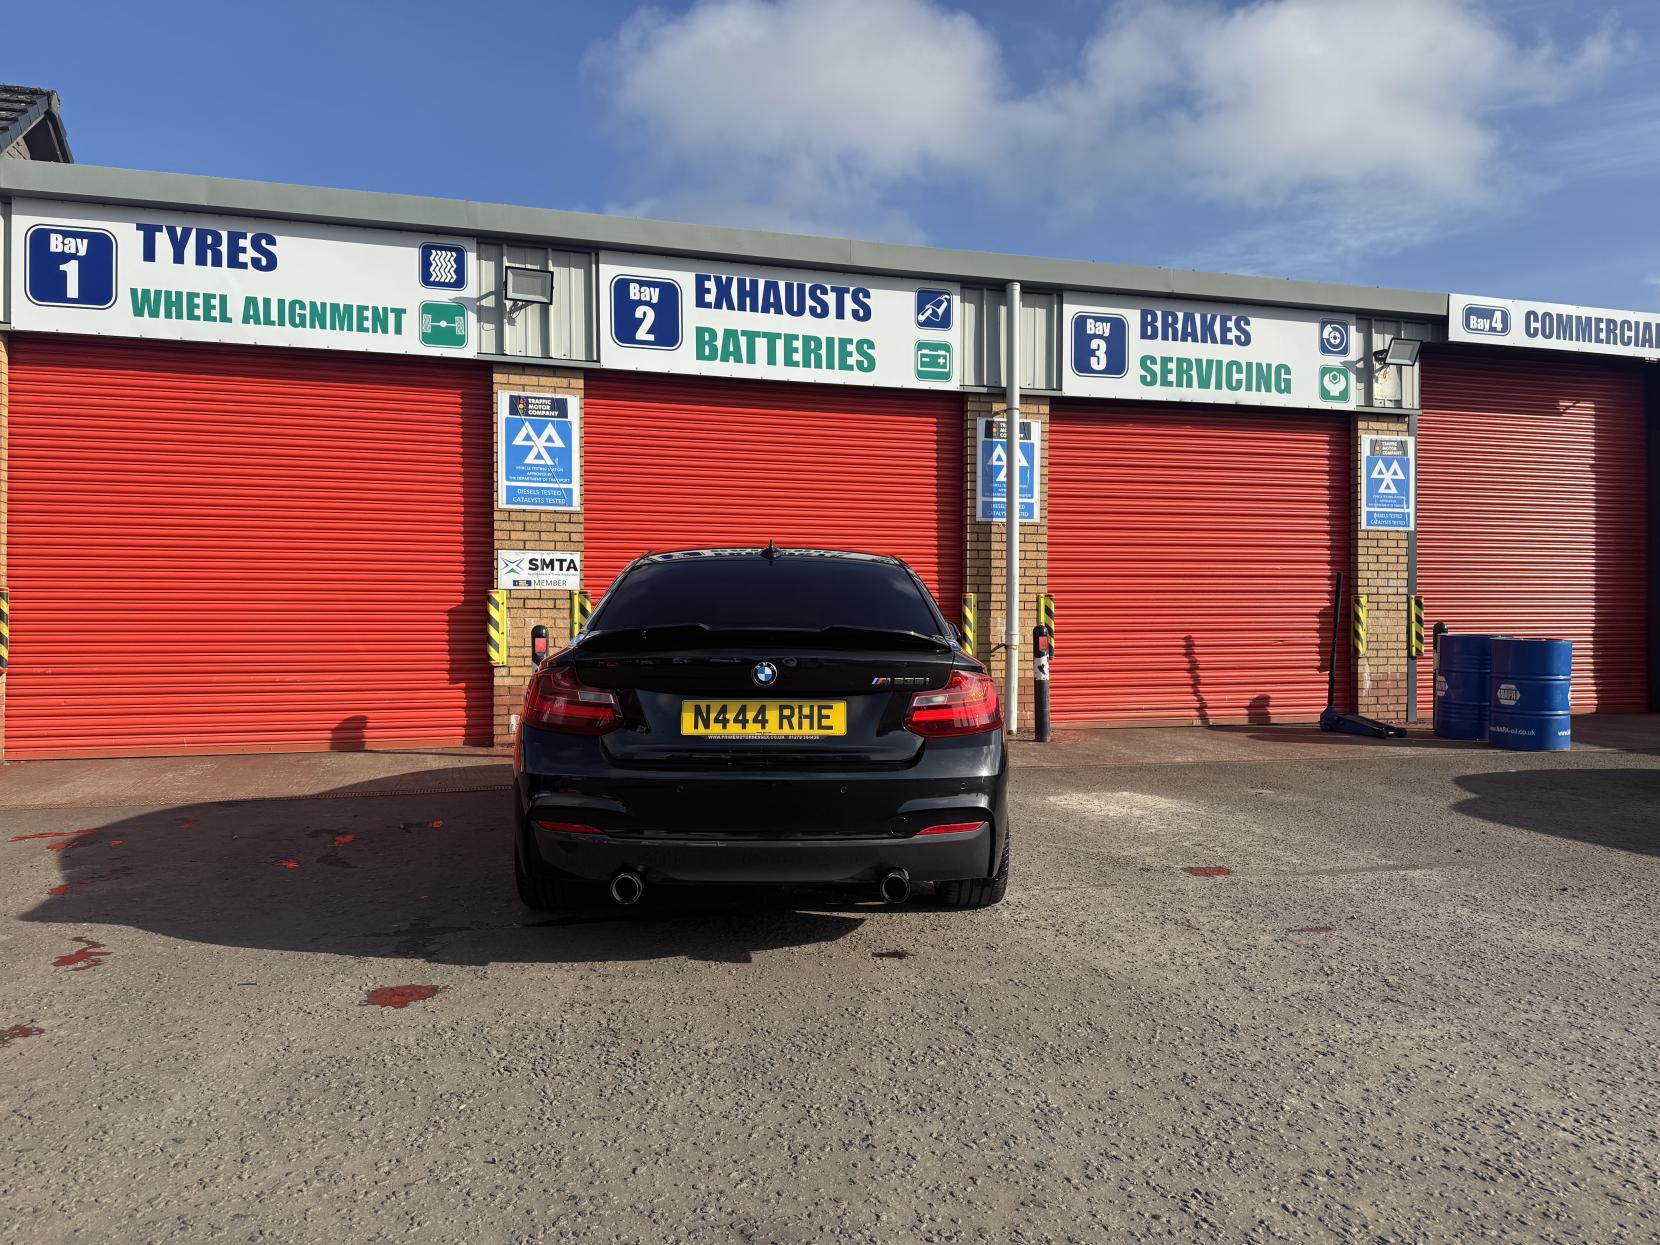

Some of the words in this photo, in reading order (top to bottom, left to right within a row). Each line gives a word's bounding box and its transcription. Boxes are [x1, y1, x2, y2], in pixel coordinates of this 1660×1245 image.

[49, 233, 88, 257] Bay
[136, 223, 278, 272] TYRES
[59, 259, 80, 299] 1
[629, 283, 660, 304] Bay
[129, 287, 233, 324] WHEEL
[241, 295, 407, 336] ALIGNMENT
[695, 273, 872, 322] EXHAUSTS
[634, 305, 655, 341] 2
[1086, 318, 1111, 337] Bay
[1139, 308, 1251, 347] BRAKES
[1470, 315, 1490, 332] Bay
[1491, 310, 1503, 332] 4
[695, 326, 877, 373] BATTERIES
[1090, 338, 1107, 371] 3
[1139, 354, 1292, 394] SERVICING
[512, 496, 545, 504] CATALYSTS
[528, 557, 579, 572] SMTA
[533, 579, 567, 587] MEMBER
[1500, 688, 1516, 700] NAPA
[693, 703, 769, 730] N444
[778, 704, 834, 730] RHE
